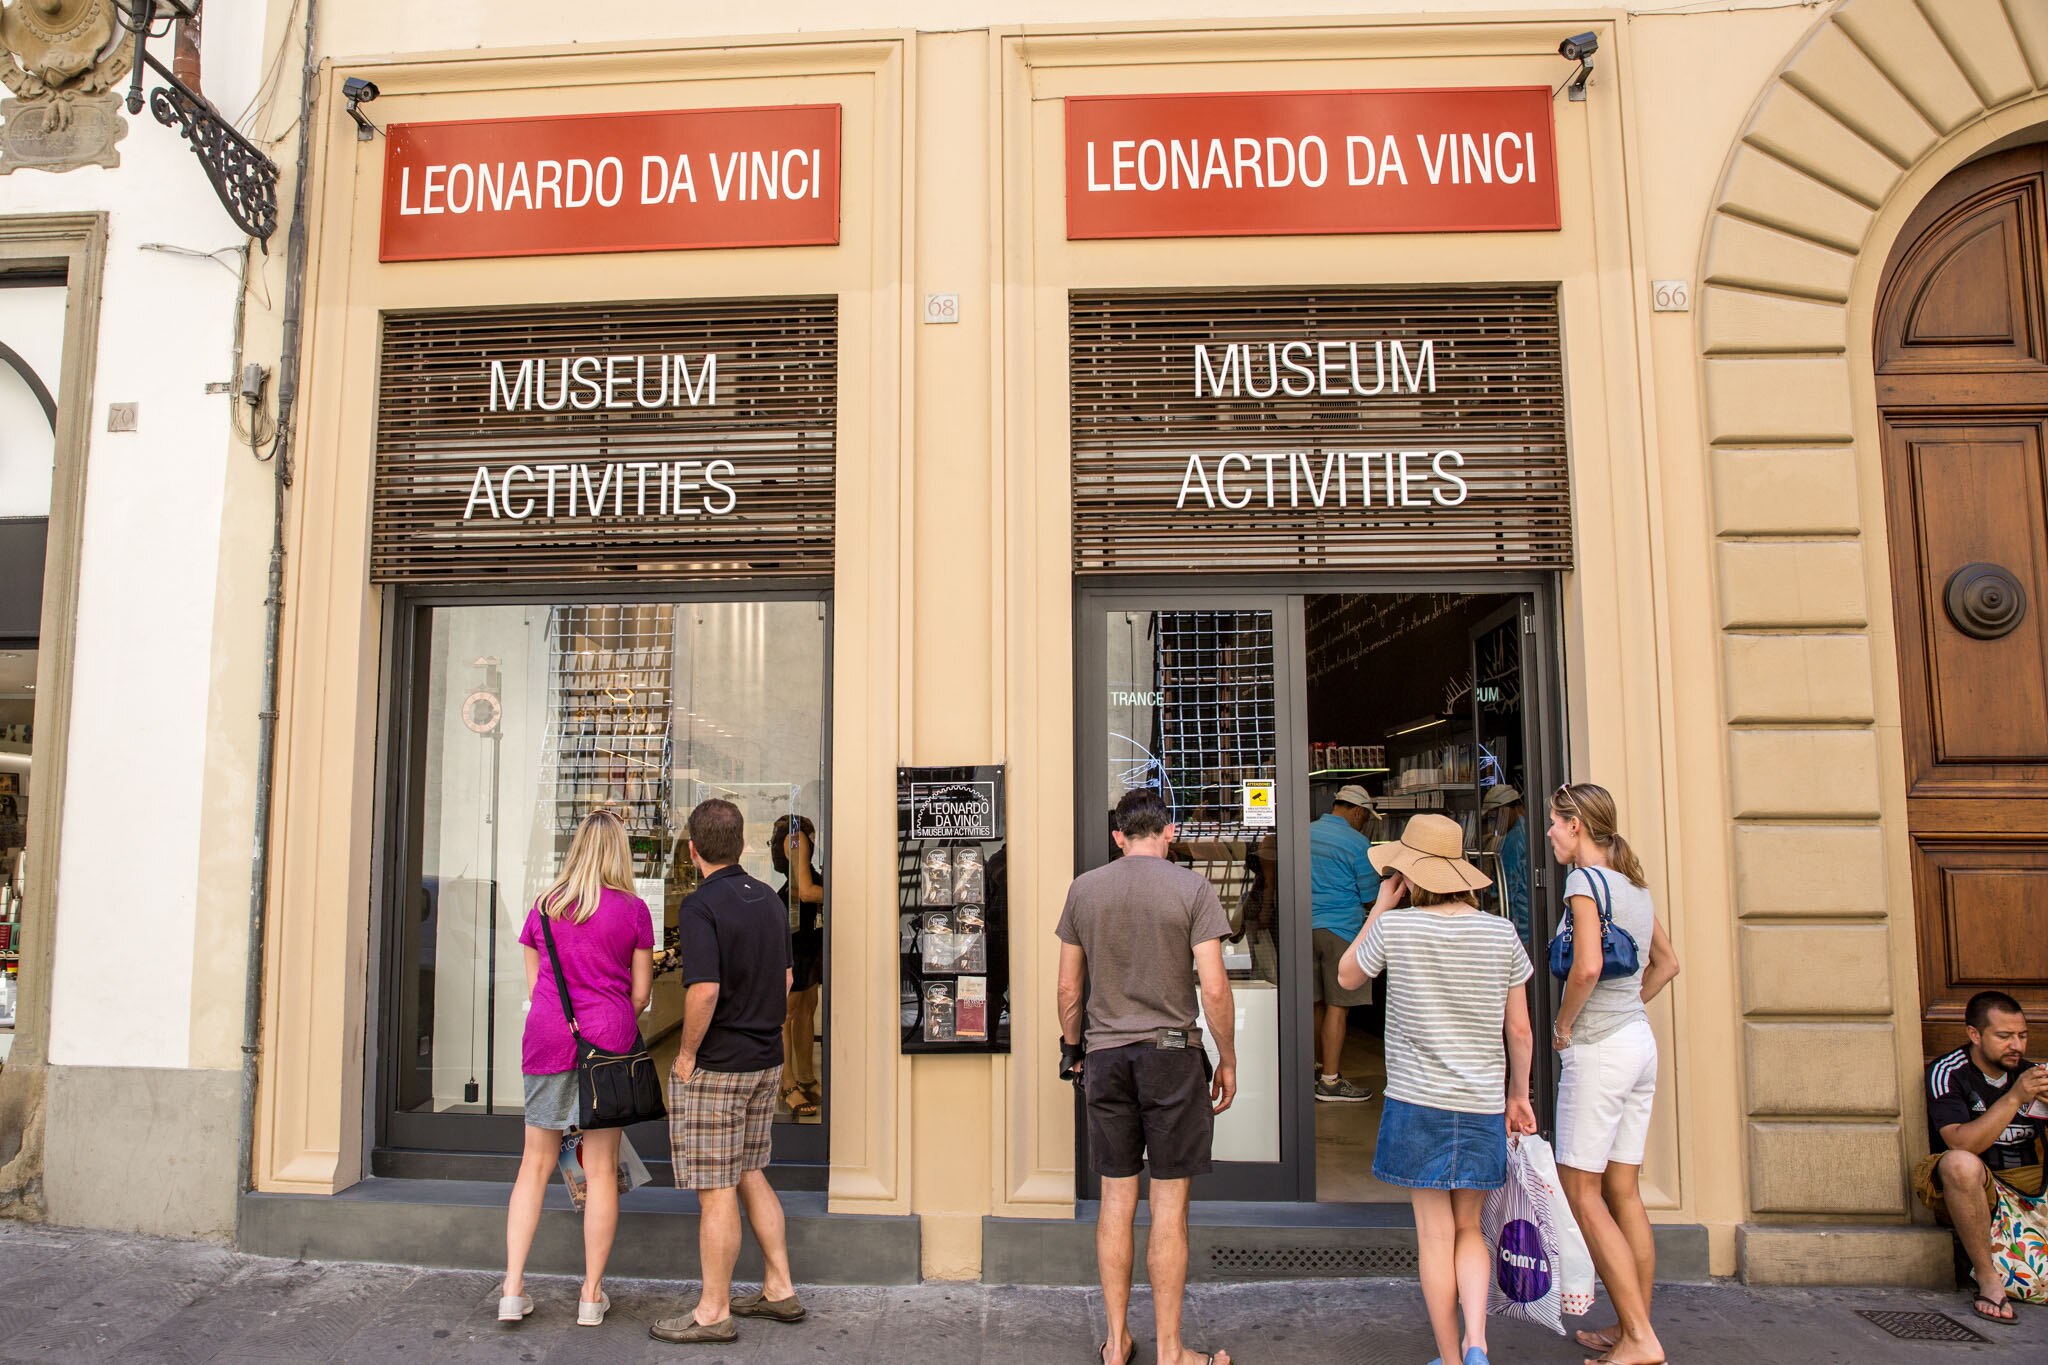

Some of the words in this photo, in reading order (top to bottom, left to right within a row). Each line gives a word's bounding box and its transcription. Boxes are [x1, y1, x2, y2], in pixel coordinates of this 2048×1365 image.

[1086, 134, 1328, 193] LEONARDO
[1346, 134, 1409, 187] DA
[1416, 131, 1538, 185] VINCI
[400, 156, 624, 216] LEONARDO
[640, 153, 697, 205] DA
[708, 148, 821, 202] VINCI
[928, 295, 955, 317] 68
[1655, 285, 1687, 307] 66
[1194, 340, 1436, 399] MUSEUM
[489, 353, 717, 412] MUSEUM
[111, 407, 135, 427] 70
[463, 459, 737, 520] ACTIVITIES
[1176, 450, 1468, 510] ACTIVITIES
[1111, 691, 1164, 707] TRANCE
[929, 801, 989, 815] LEONARDO
[922, 827, 953, 837] MUSEUM
[954, 827, 991, 837] ACTIVITIES
[935, 814, 952, 827] DA
[953, 814, 982, 827] VINCI
[1500, 1246, 1537, 1270] OMMY
